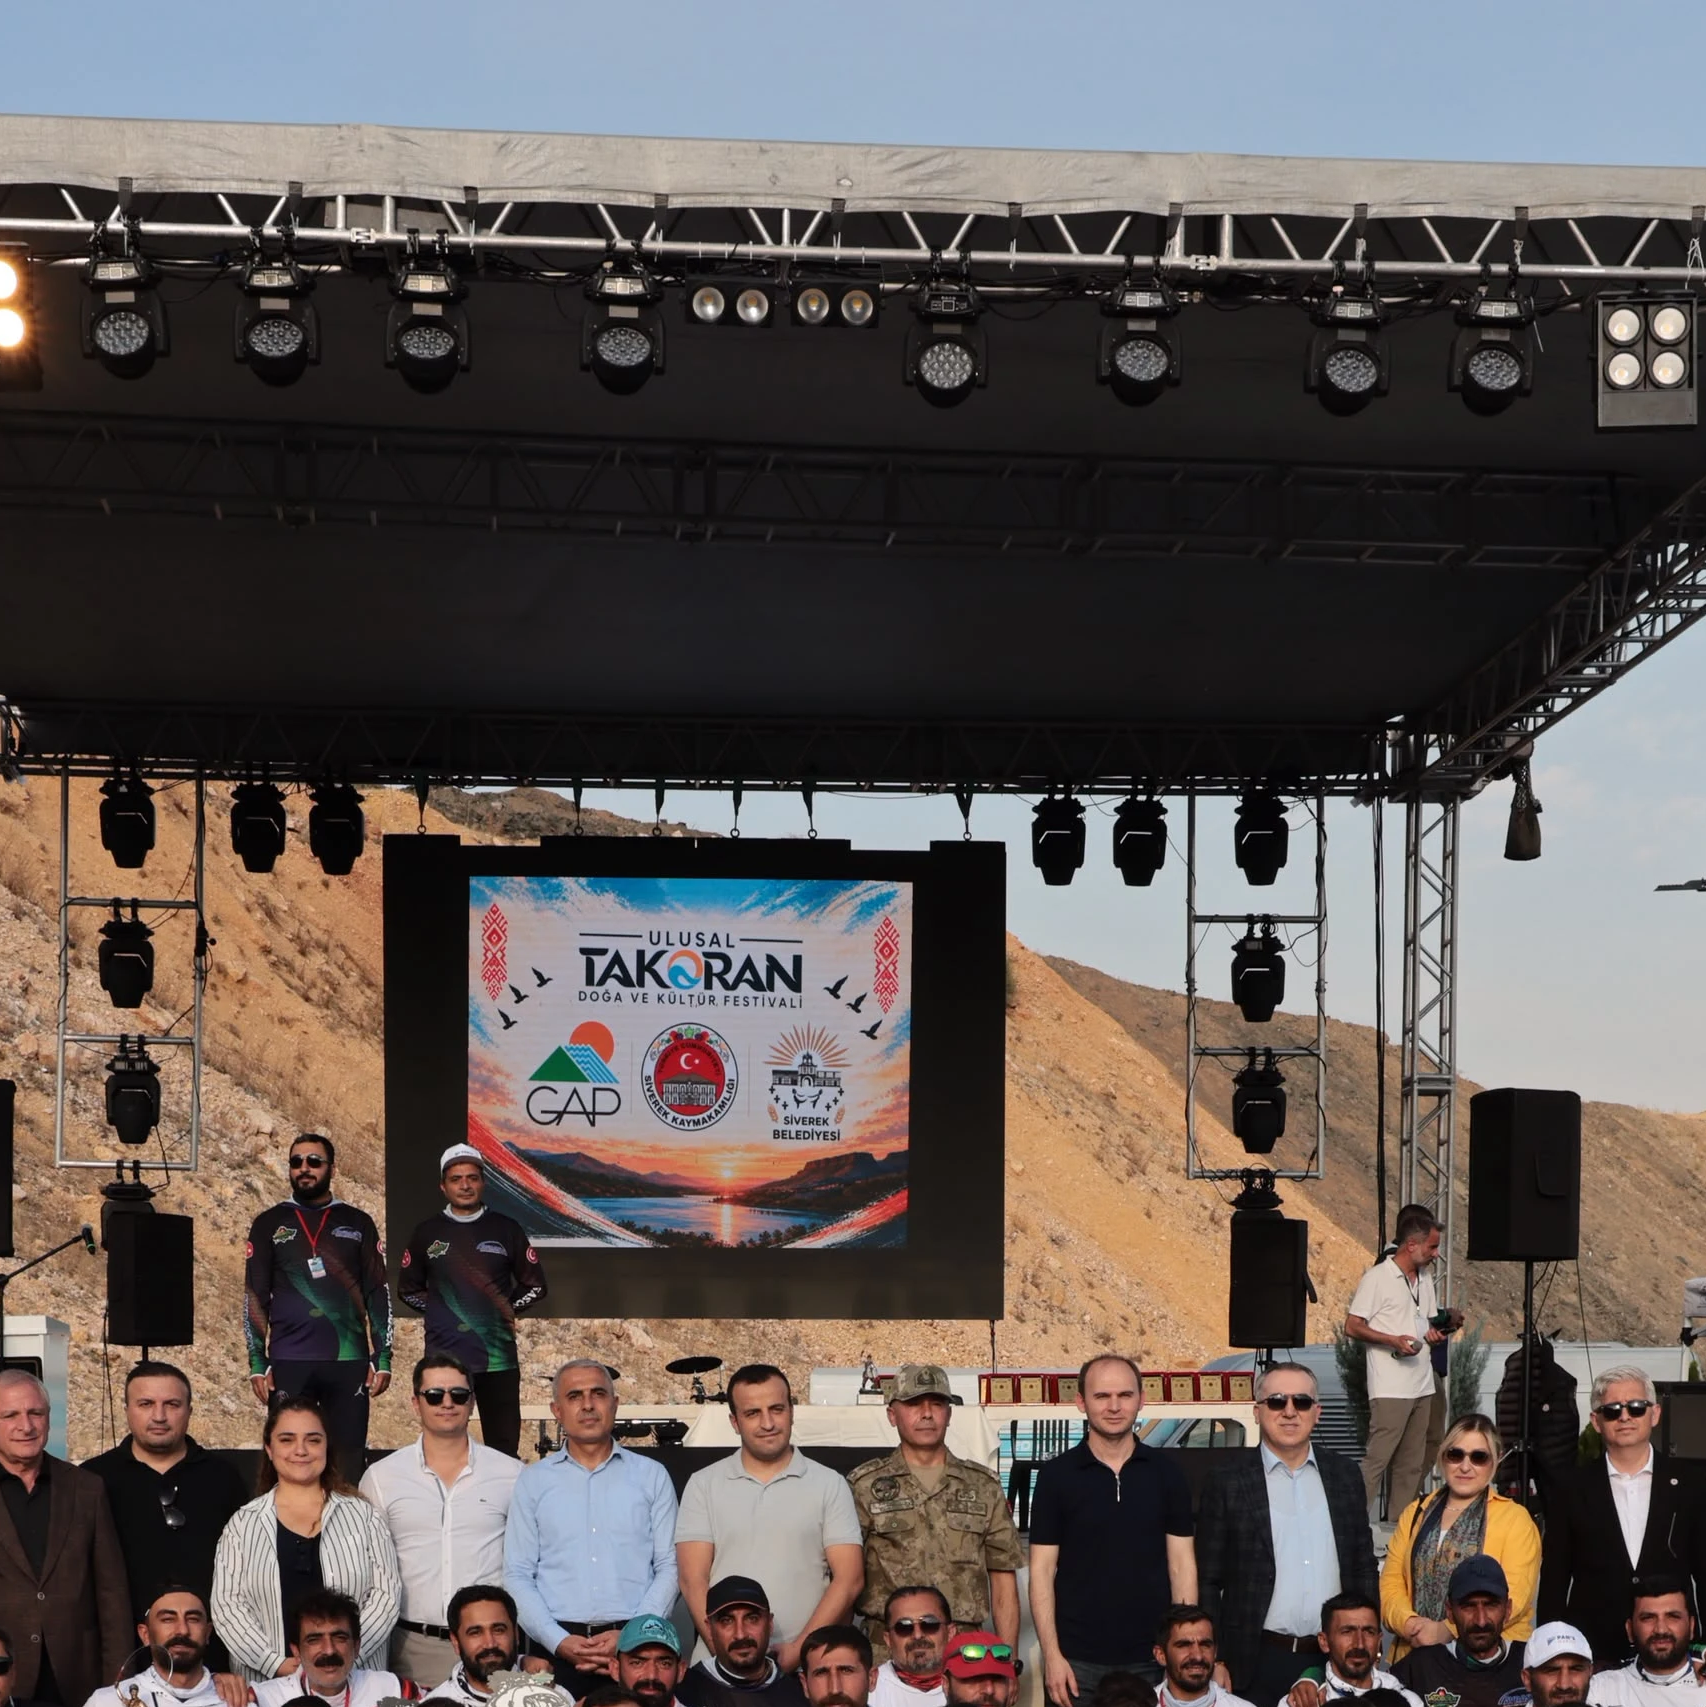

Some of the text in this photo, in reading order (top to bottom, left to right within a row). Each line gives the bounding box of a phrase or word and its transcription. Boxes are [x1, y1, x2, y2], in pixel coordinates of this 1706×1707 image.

[648, 930, 736, 949] ULUSAL
[579, 947, 803, 994] TAKORAN
[578, 988, 804, 1010] DOĞA VE KÜLTÜR FESTİVALİ
[526, 1086, 621, 1128] GAP
[644, 1074, 735, 1128] SİVEREK KAYMAKAMLIĞI
[783, 1114, 830, 1128] SİVEREK
[772, 1128, 842, 1142] BELEDİYESİ
